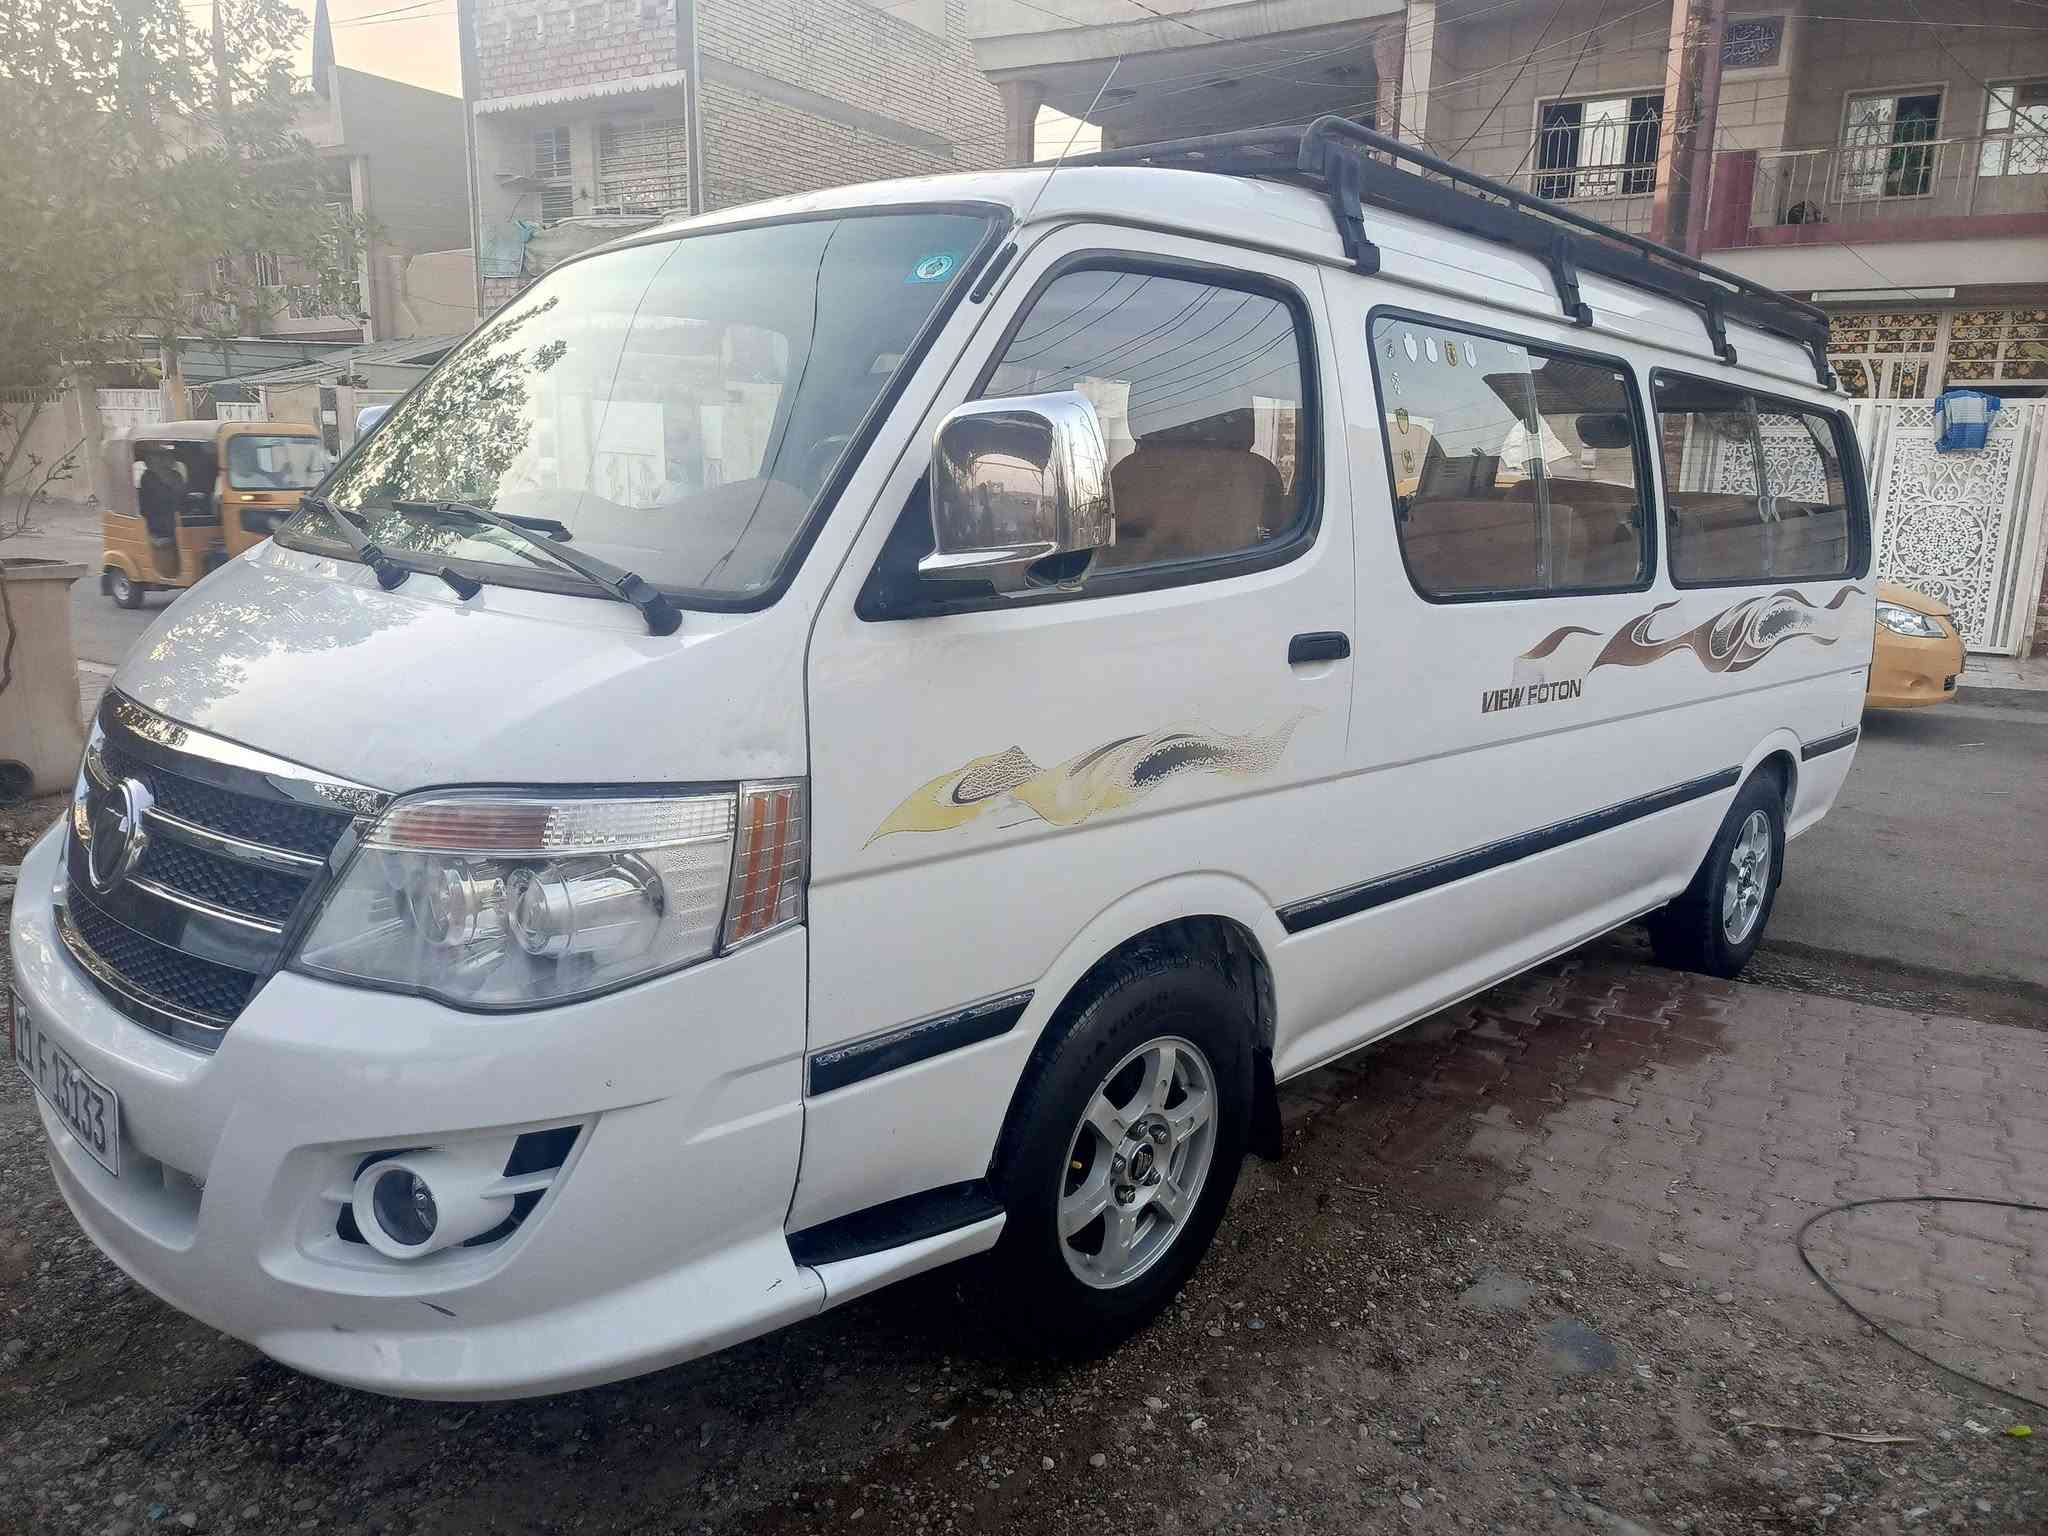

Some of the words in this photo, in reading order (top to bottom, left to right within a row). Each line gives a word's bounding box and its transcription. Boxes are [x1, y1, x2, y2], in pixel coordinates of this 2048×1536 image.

[1481, 686, 1526, 713] VIEW
[1527, 678, 1582, 705] FOTON
[38, 1031, 48, 1084] F
[52, 1049, 106, 1153] 13133
